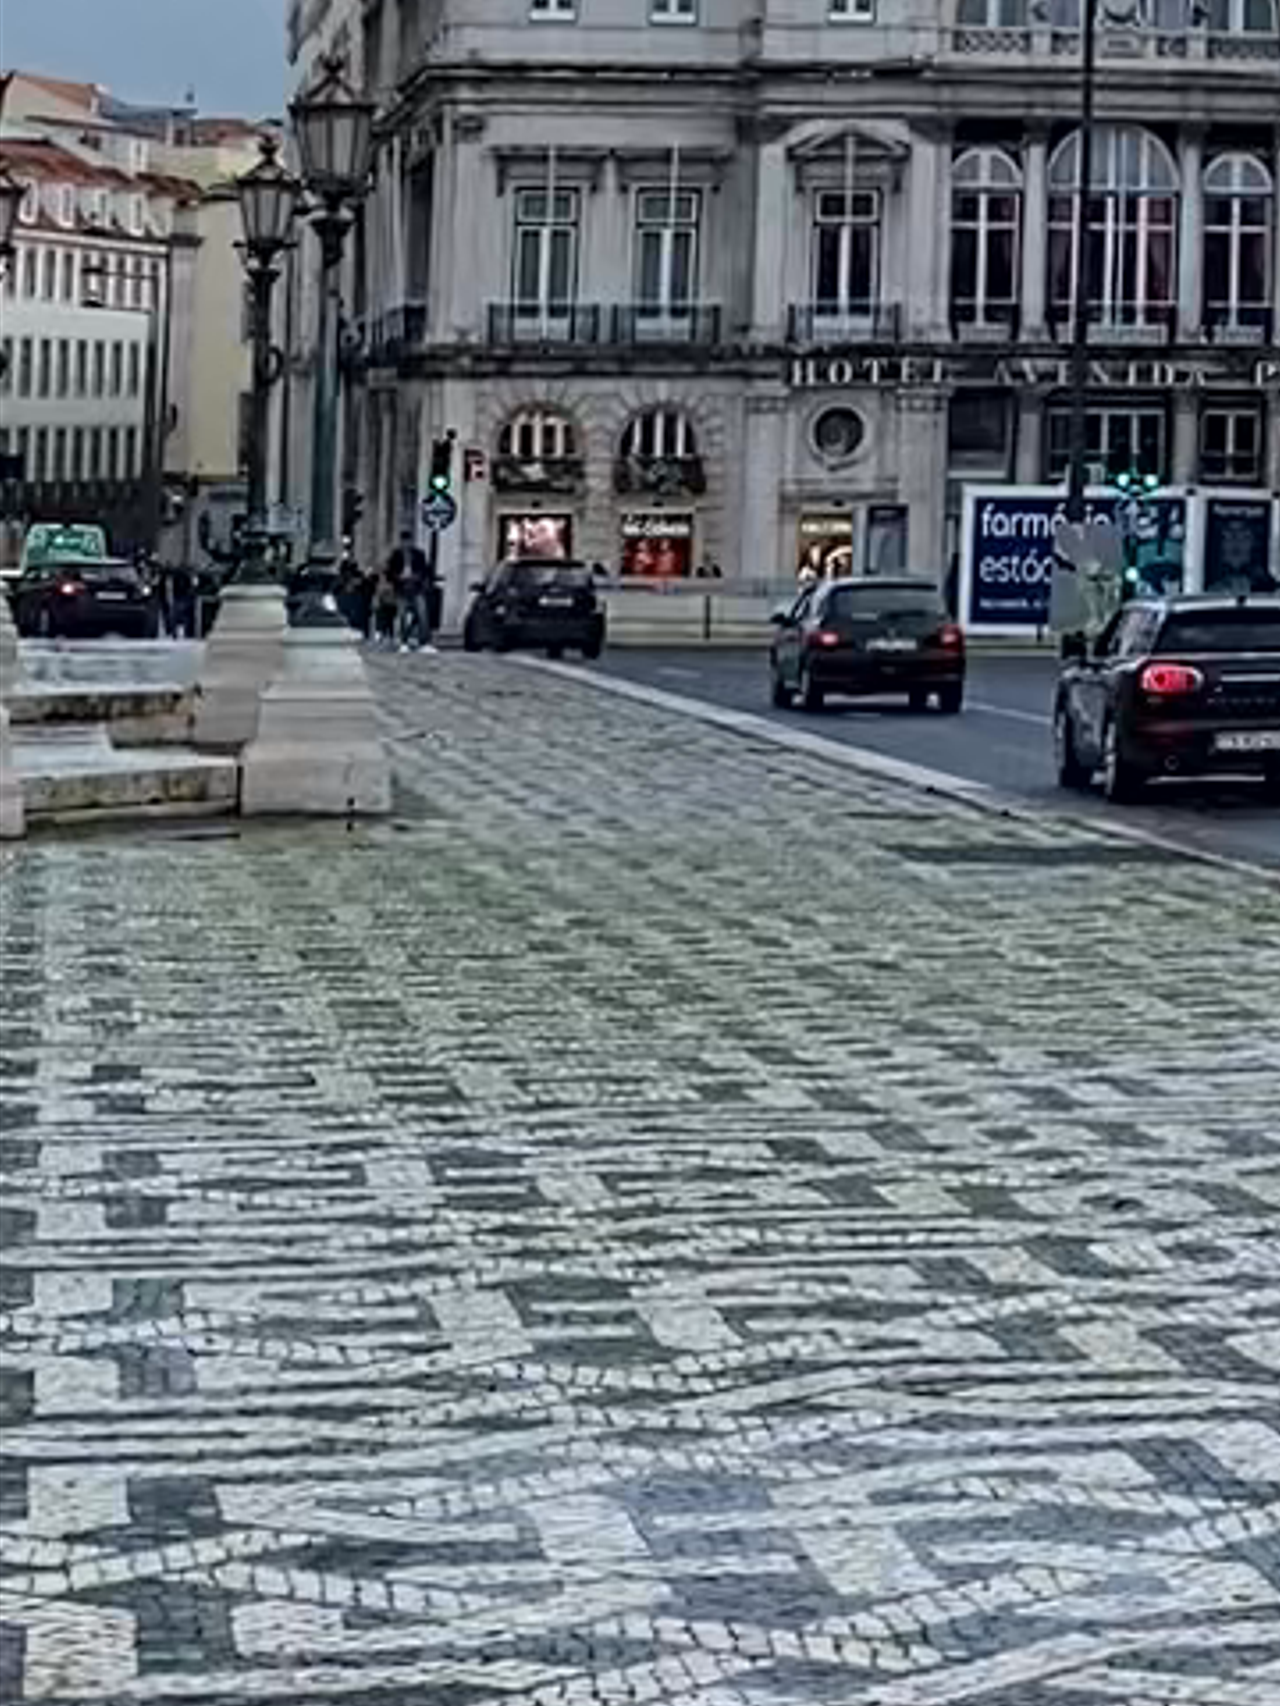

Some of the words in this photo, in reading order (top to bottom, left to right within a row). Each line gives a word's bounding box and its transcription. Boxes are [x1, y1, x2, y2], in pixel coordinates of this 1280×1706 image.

[791, 356, 949, 384] HOTEL
[994, 358, 1207, 386] AVENIDA
[981, 502, 1115, 538] farmái
